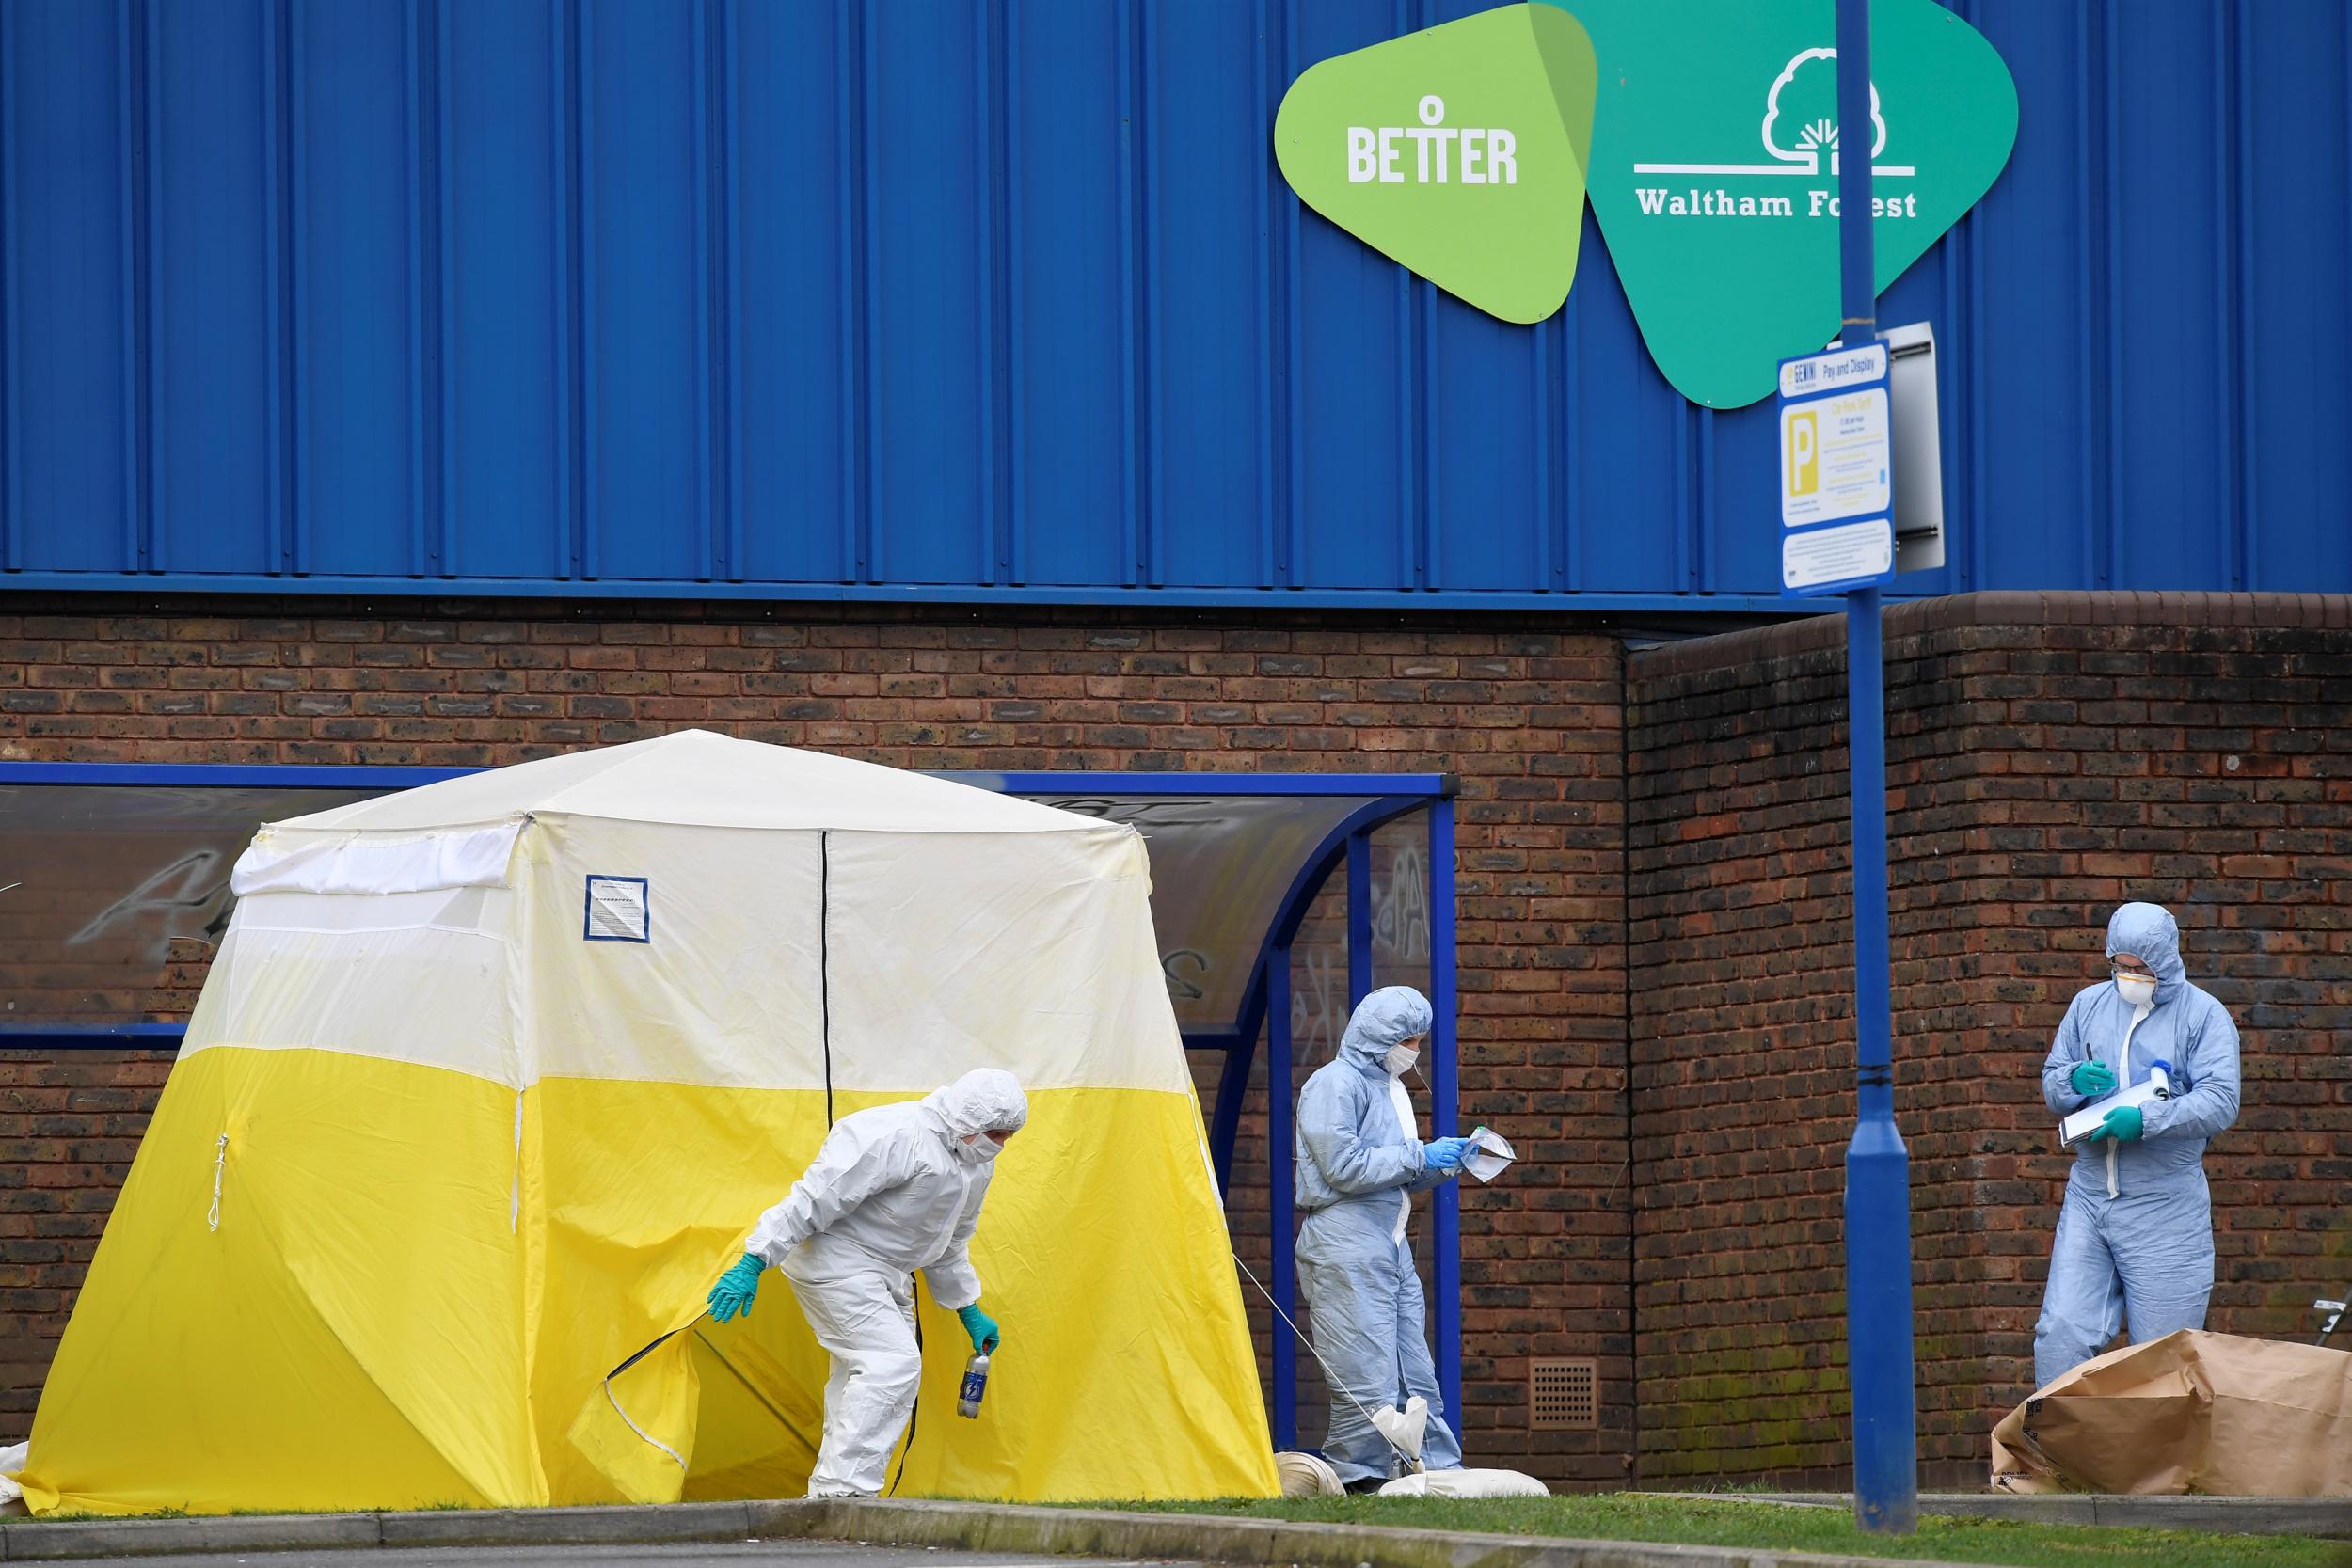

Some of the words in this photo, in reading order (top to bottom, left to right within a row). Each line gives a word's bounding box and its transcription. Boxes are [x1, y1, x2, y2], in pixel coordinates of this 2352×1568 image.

[1347, 126, 1518, 184] BETTER
[1635, 188, 1793, 217] Waltham
[1807, 190, 1916, 218] Foest
[1823, 364, 1835, 380] Pay
[1836, 362, 1849, 376] and
[1850, 356, 1874, 375] Display
[1792, 417, 1814, 492] P
